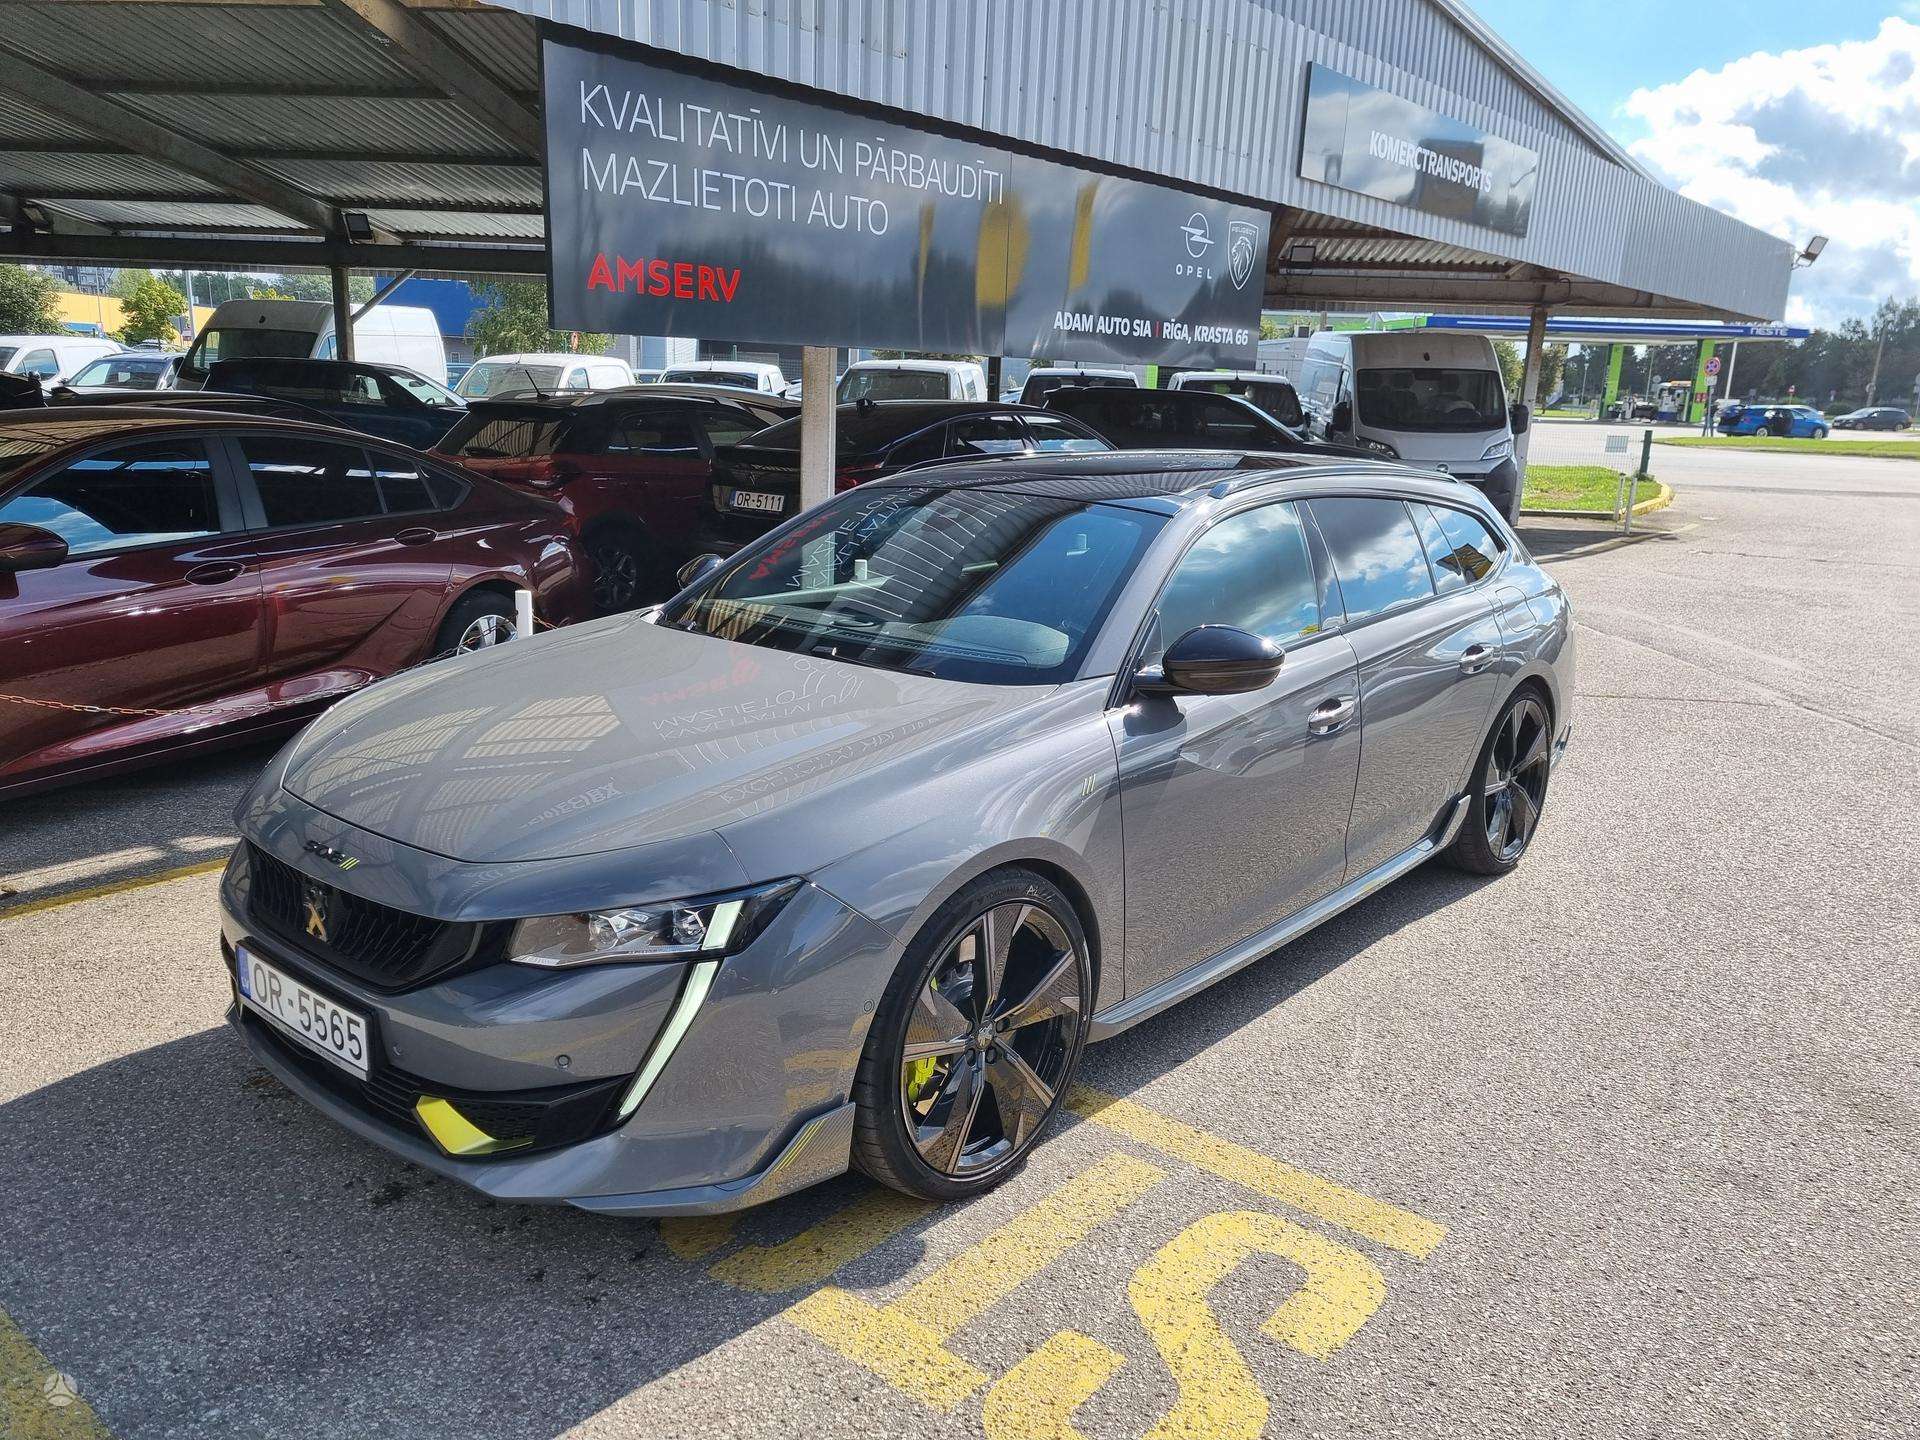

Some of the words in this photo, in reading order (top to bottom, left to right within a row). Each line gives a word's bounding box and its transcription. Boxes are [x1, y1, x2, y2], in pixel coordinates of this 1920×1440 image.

[580, 80, 787, 163] KVALITATĪVI
[800, 129, 843, 174] UN
[855, 137, 1004, 205] PĀRBAUDĪTI
[1369, 130, 1493, 193] KOMERCTRANSPORTS
[582, 147, 797, 223] MAZLIETOTI
[807, 189, 889, 236] AUTO
[586, 252, 742, 303] AMSERV
[1175, 263, 1213, 280] OPEL
[1053, 310, 1094, 333] ADAM
[1096, 315, 1130, 337] AUTO
[1132, 318, 1151, 338] SIA
[1162, 318, 1192, 345] RĪGA,
[1194, 324, 1234, 345] KRASTA
[1235, 328, 1249, 346] 66
[736, 492, 782, 511] OR-5111
[253, 962, 363, 1062] OR-5565
